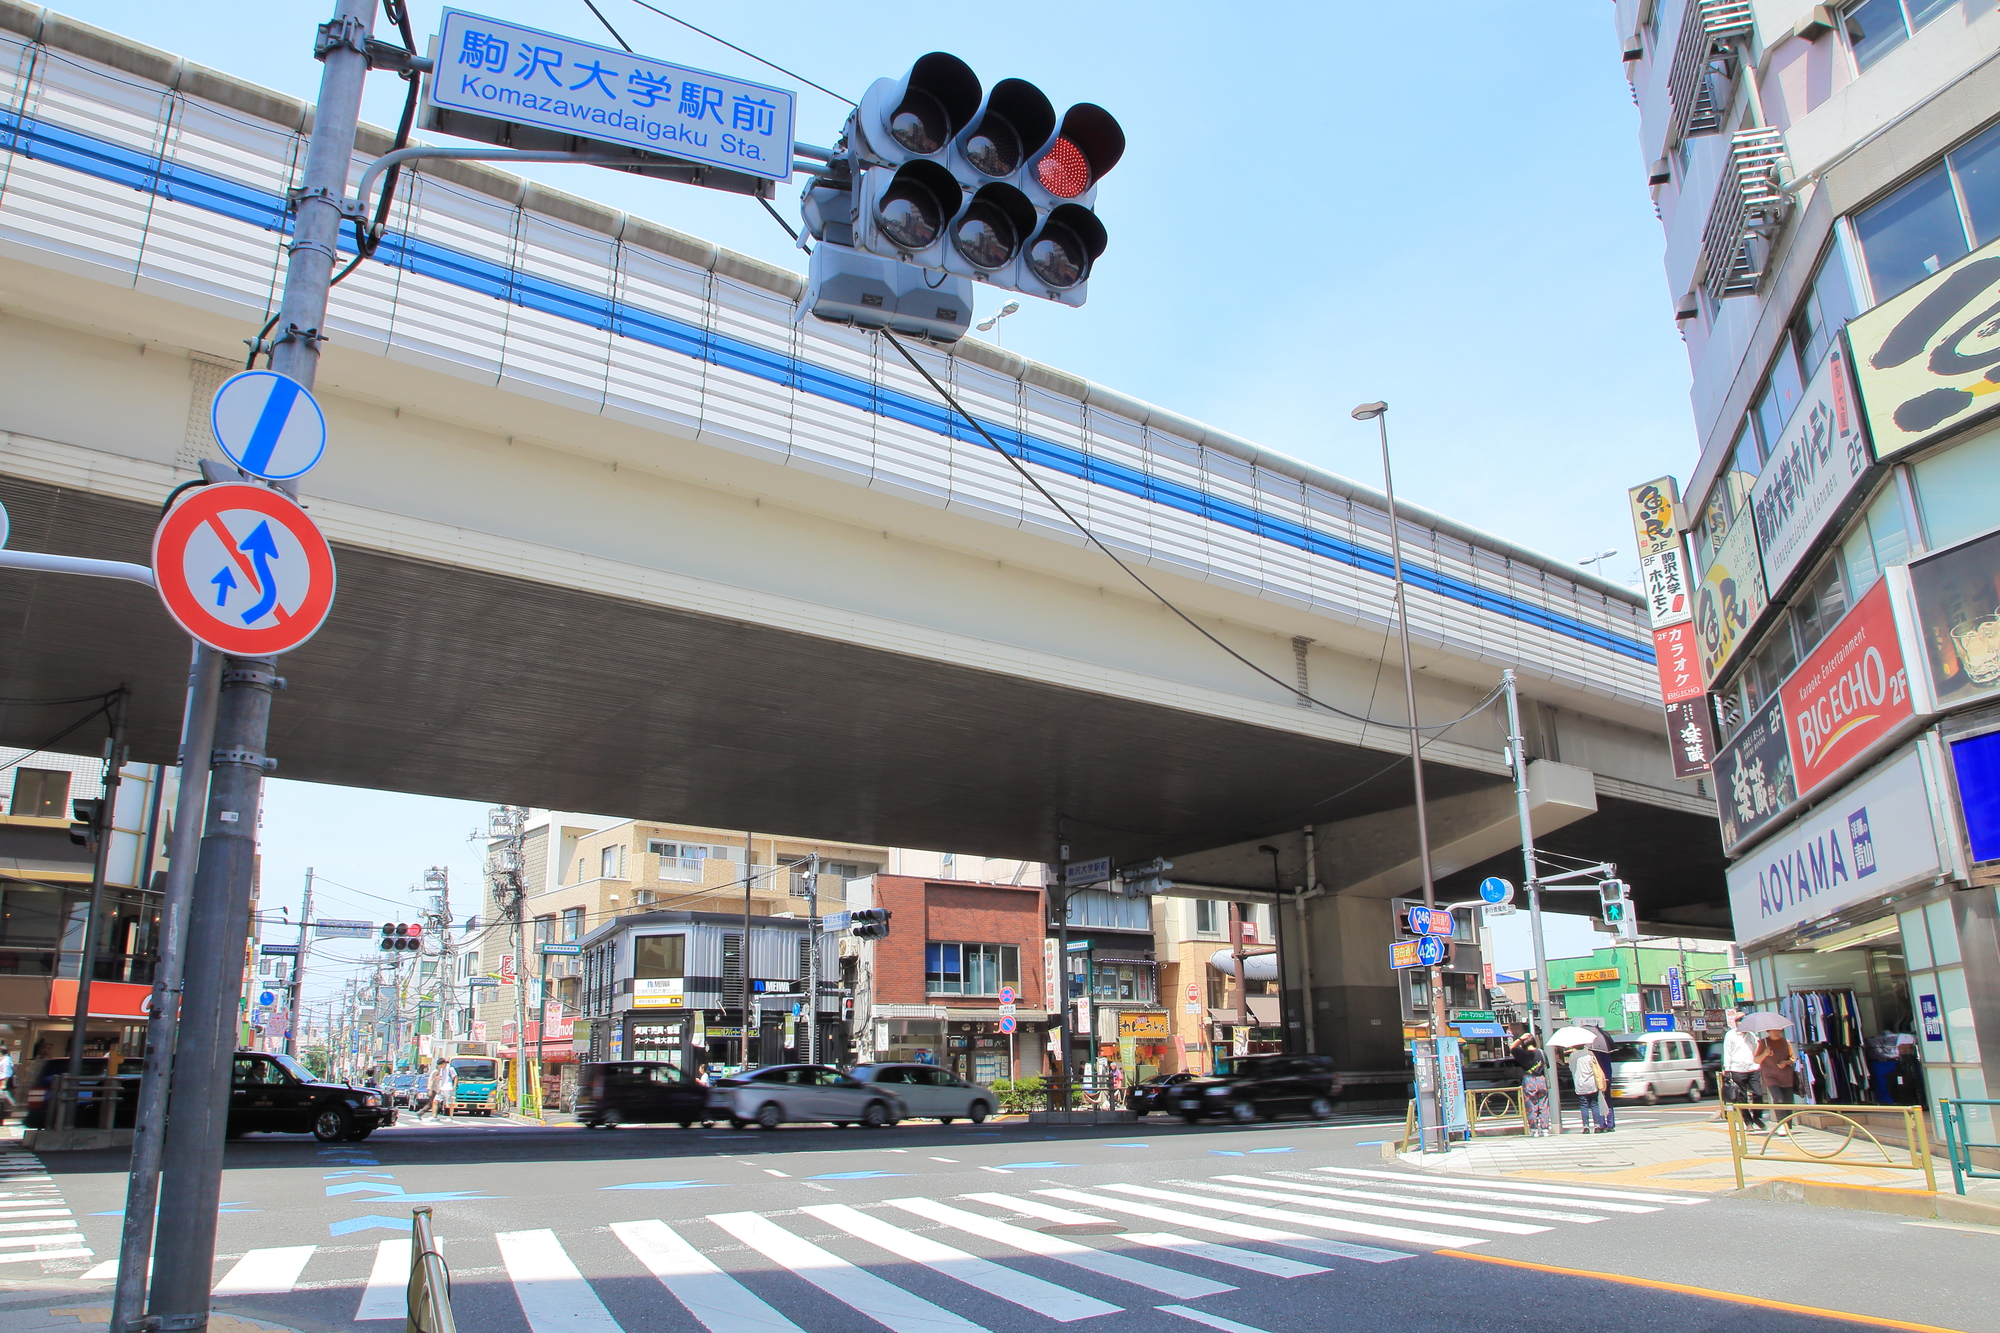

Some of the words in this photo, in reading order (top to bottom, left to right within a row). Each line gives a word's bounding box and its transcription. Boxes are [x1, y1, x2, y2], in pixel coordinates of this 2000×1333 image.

[458, 29, 776, 137] 駒沢大学駅前
[461, 74, 708, 148] Komazawadaigaku
[720, 133, 766, 162] Sta.
[1847, 432, 1863, 478] 2F
[1755, 398, 1835, 557] 駒沢大学ホルモン
[1636, 486, 1673, 541] 魚民
[1644, 557, 1655, 567] 2F
[1651, 541, 1668, 553] 2F
[1661, 552, 1681, 594] 駒沢大学
[1649, 569, 1668, 617] ホルモン
[1753, 572, 1764, 610] 2F
[1657, 632, 1667, 640] 2F
[1669, 629, 1689, 687] カラオケ
[1799, 674, 1821, 701] Karaoke
[1821, 626, 1866, 680] Entertainment
[1889, 668, 1907, 706] 2F
[1667, 703, 1679, 713] 2F
[1769, 704, 1781, 735] 2F
[1797, 696, 1832, 768] BIG
[1828, 646, 1886, 724] ECHO
[1680, 722, 1706, 762] 楽蔵
[1730, 748, 1771, 823] 楽蔵
[1850, 817, 1868, 840] 洋服の
[1068, 861, 1107, 877] 駒沢大学駅前
[1853, 840, 1874, 872] 青山
[1758, 828, 1848, 919] AOYAMA
[824, 913, 850, 925] 駒沢大学駅前
[1416, 912, 1430, 924] 246
[1431, 914, 1449, 926] 玉川通り
[1393, 944, 1416, 959] 自由通り
[1419, 944, 1435, 959] 426
[654, 980, 670, 988] MEIWA
[765, 981, 790, 993] MEIWA
[1578, 970, 1615, 980] きかく寿司
[1922, 1001, 1936, 1013] 洋服の
[634, 1026, 680, 1035] 賃貸・売買・管理
[1924, 1016, 1941, 1035] 青山
[1444, 1055, 1456, 1122] 自転車ナビライン
